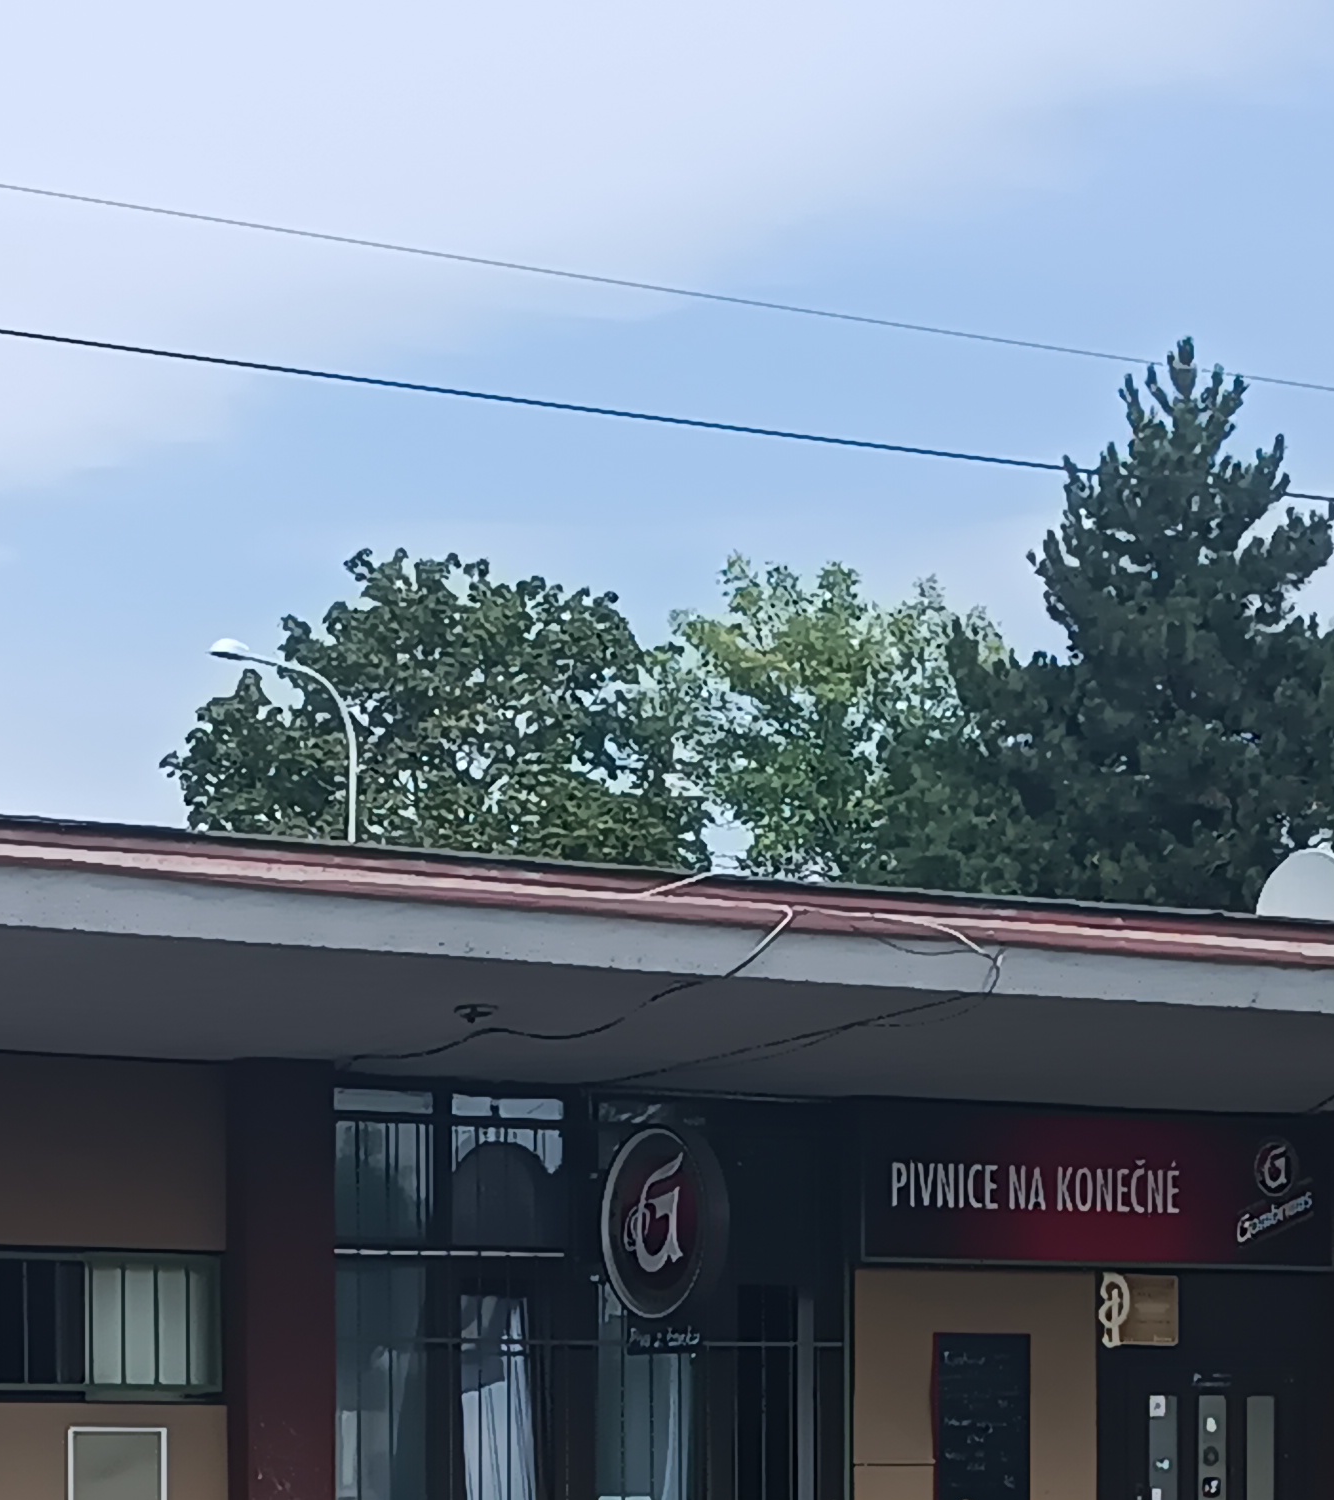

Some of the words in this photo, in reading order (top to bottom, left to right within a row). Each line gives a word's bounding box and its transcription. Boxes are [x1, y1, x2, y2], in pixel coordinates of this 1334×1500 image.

[891, 1161, 999, 1209] PIVNICE
[1008, 1165, 1046, 1211] NA
[1057, 1159, 1180, 1214] KONEČNÉ
